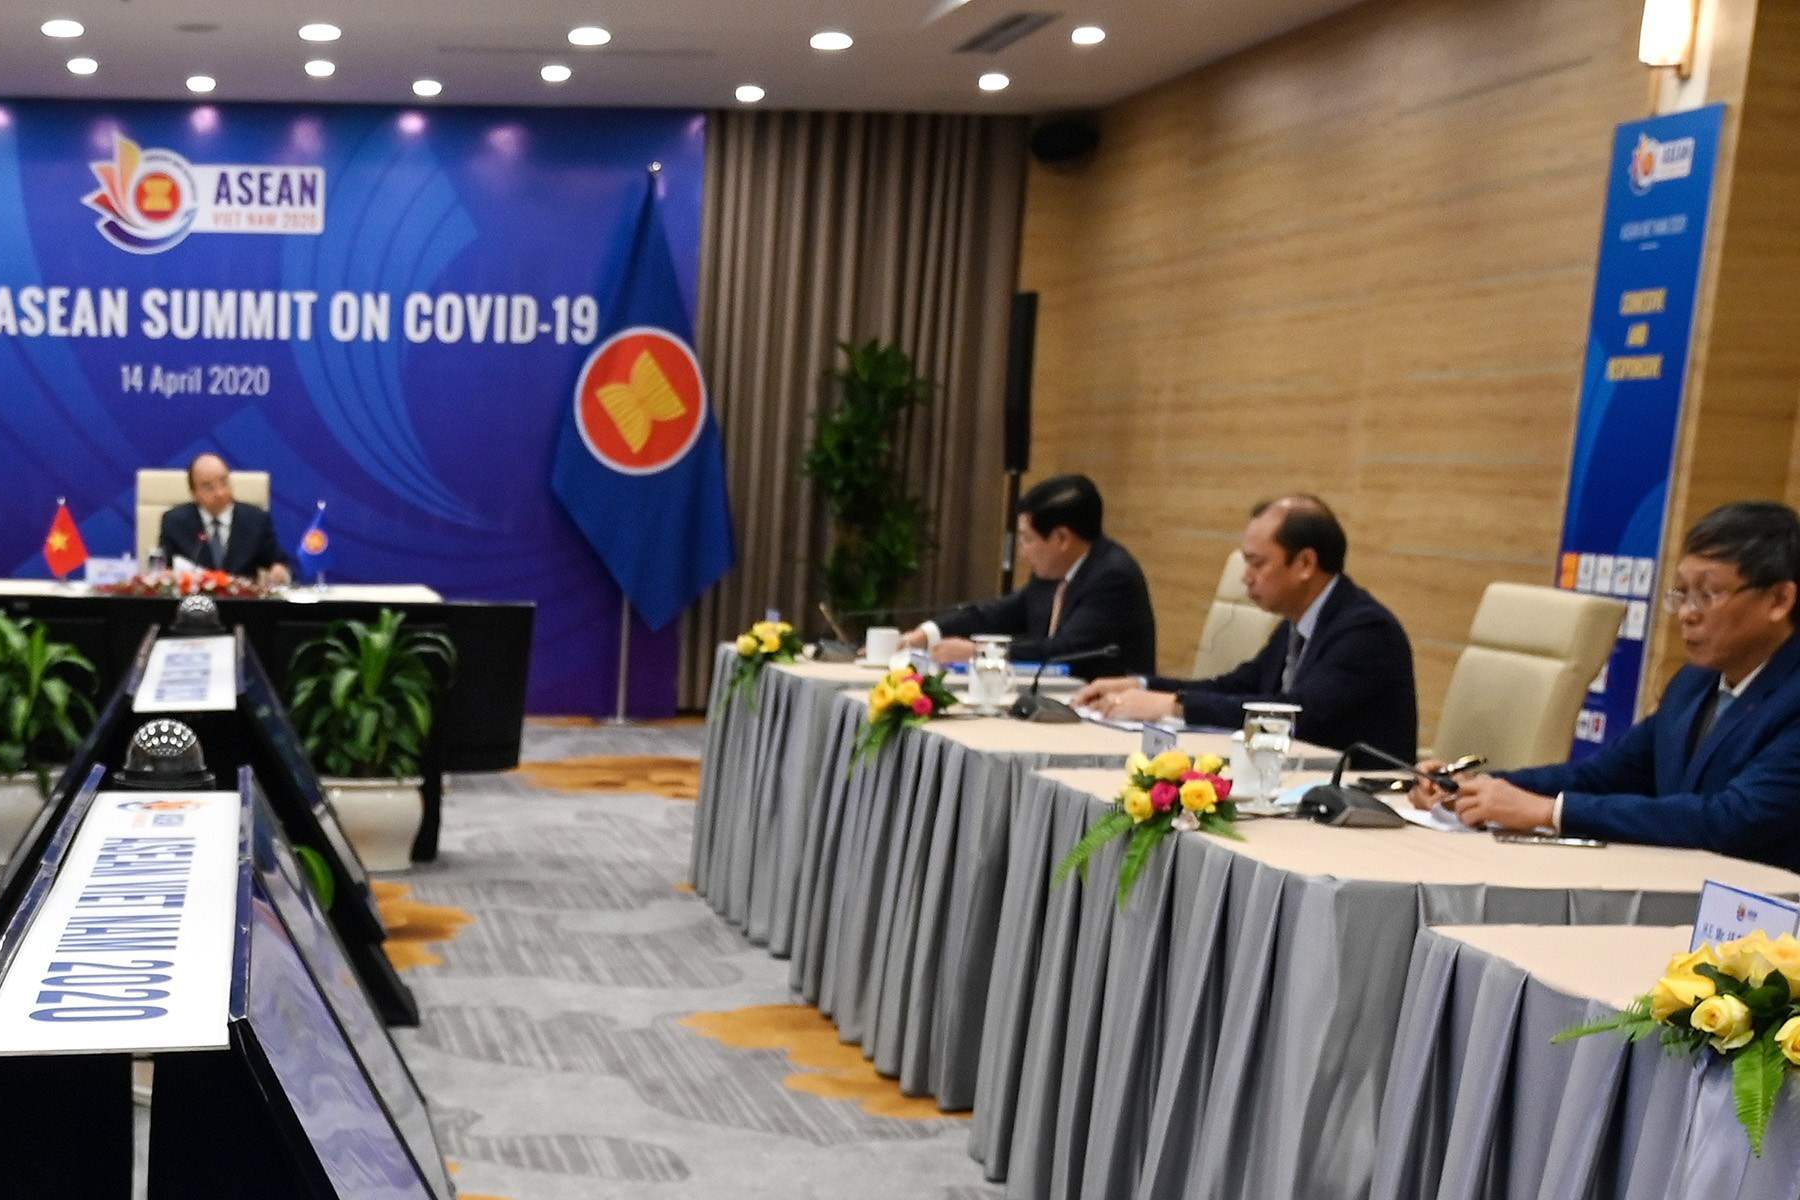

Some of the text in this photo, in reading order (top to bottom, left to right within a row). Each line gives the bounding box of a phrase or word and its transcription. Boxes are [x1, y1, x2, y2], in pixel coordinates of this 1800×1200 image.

[214, 172, 317, 207] ASEAN
[140, 289, 318, 341] SUMMIT
[329, 292, 390, 342] ON
[403, 294, 600, 345] COVID-19
[120, 364, 271, 397] 14 April 2020
[90, 836, 197, 878] ASEAN
[74, 879, 189, 909] VIET
[55, 913, 183, 953] NAM
[28, 959, 176, 1023] 2020
